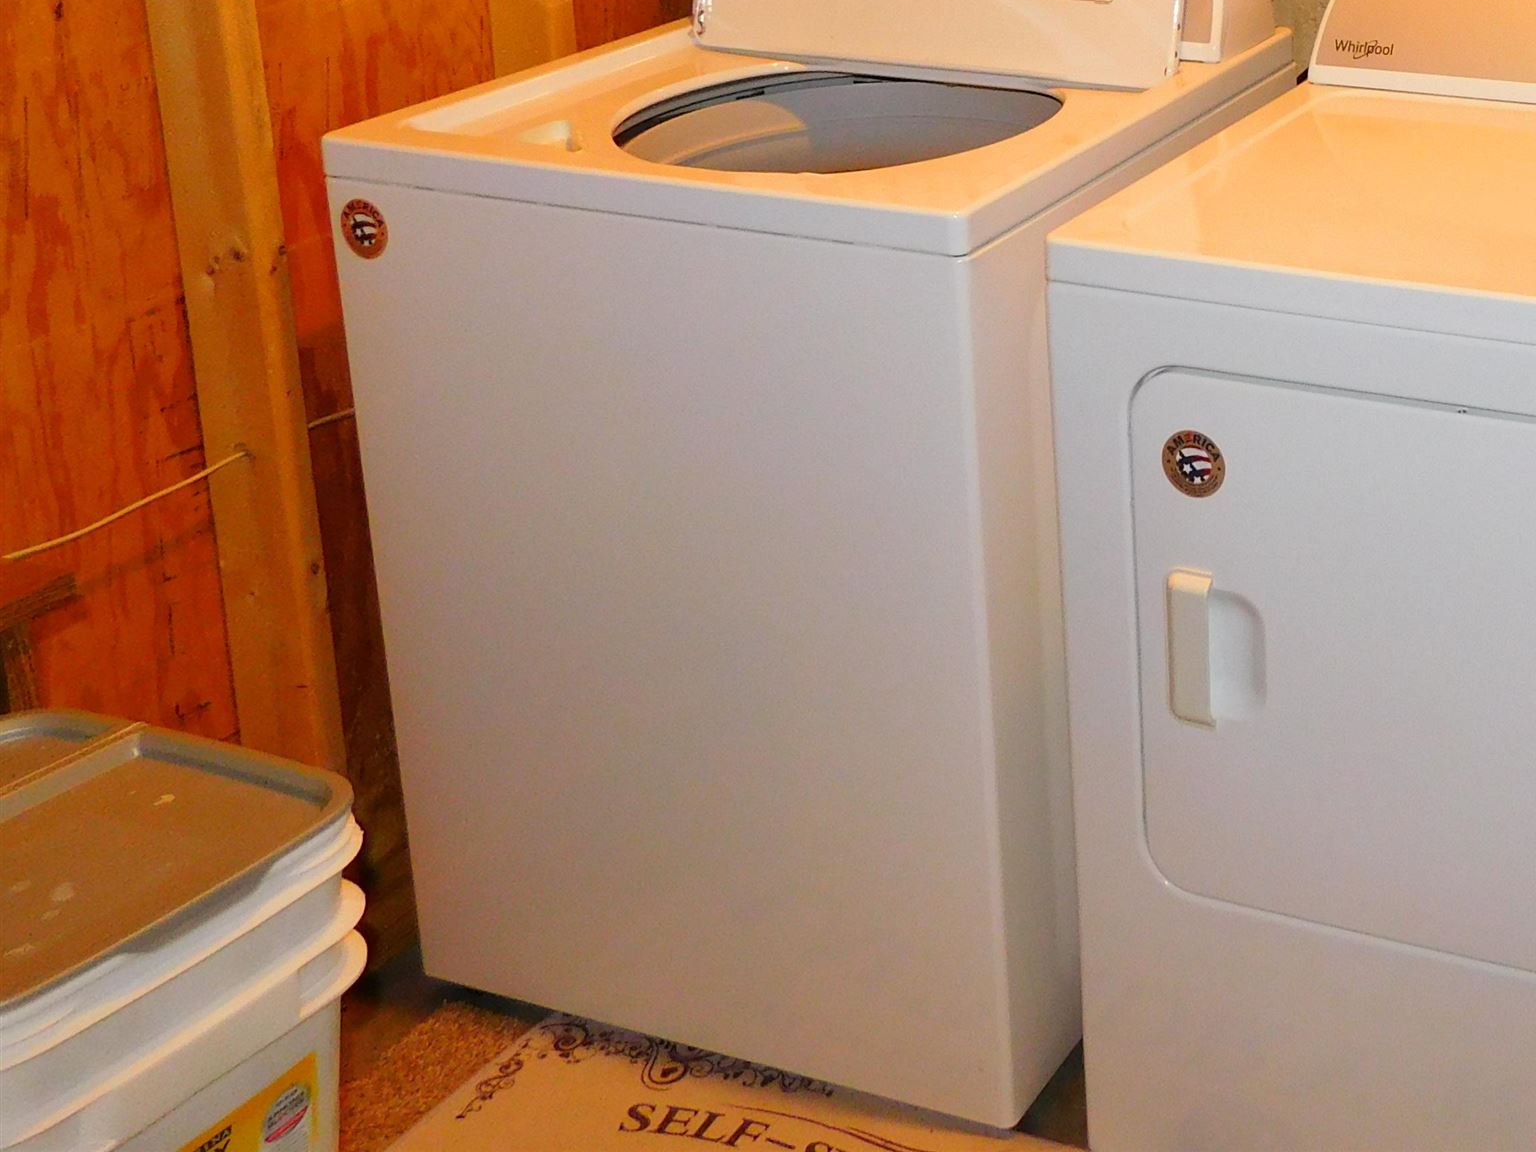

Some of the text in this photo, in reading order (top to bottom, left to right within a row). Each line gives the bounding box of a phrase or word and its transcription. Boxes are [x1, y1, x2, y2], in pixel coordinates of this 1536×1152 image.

[1334, 39, 1394, 60] Whirlpool
[1167, 433, 1220, 462] AMERICA
[618, 1103, 846, 1152] SELF-
